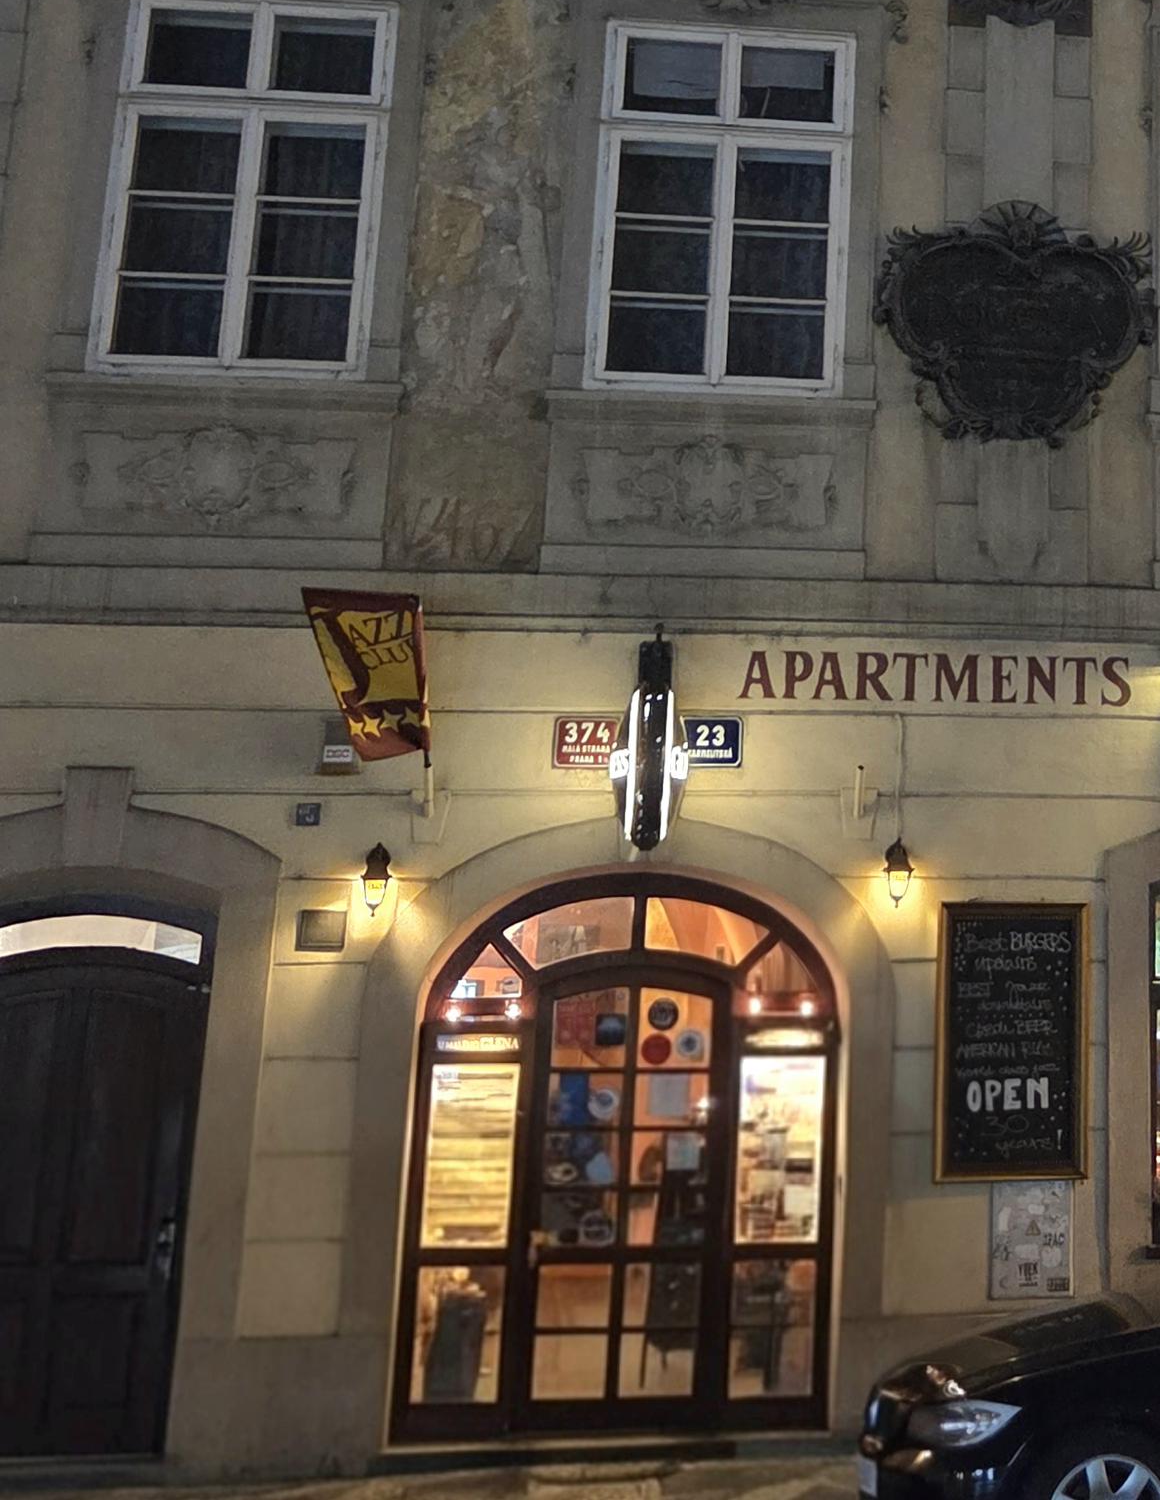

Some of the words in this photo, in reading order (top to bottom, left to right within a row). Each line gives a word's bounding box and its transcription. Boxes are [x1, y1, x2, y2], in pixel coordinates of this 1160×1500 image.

[357, 638, 414, 671] CLU
[738, 650, 1132, 707] APARTMENTS
[564, 721, 611, 744] 374
[695, 724, 726, 747] 23
[966, 1076, 1049, 1112] OPEN
[980, 1113, 1030, 1137] 30
